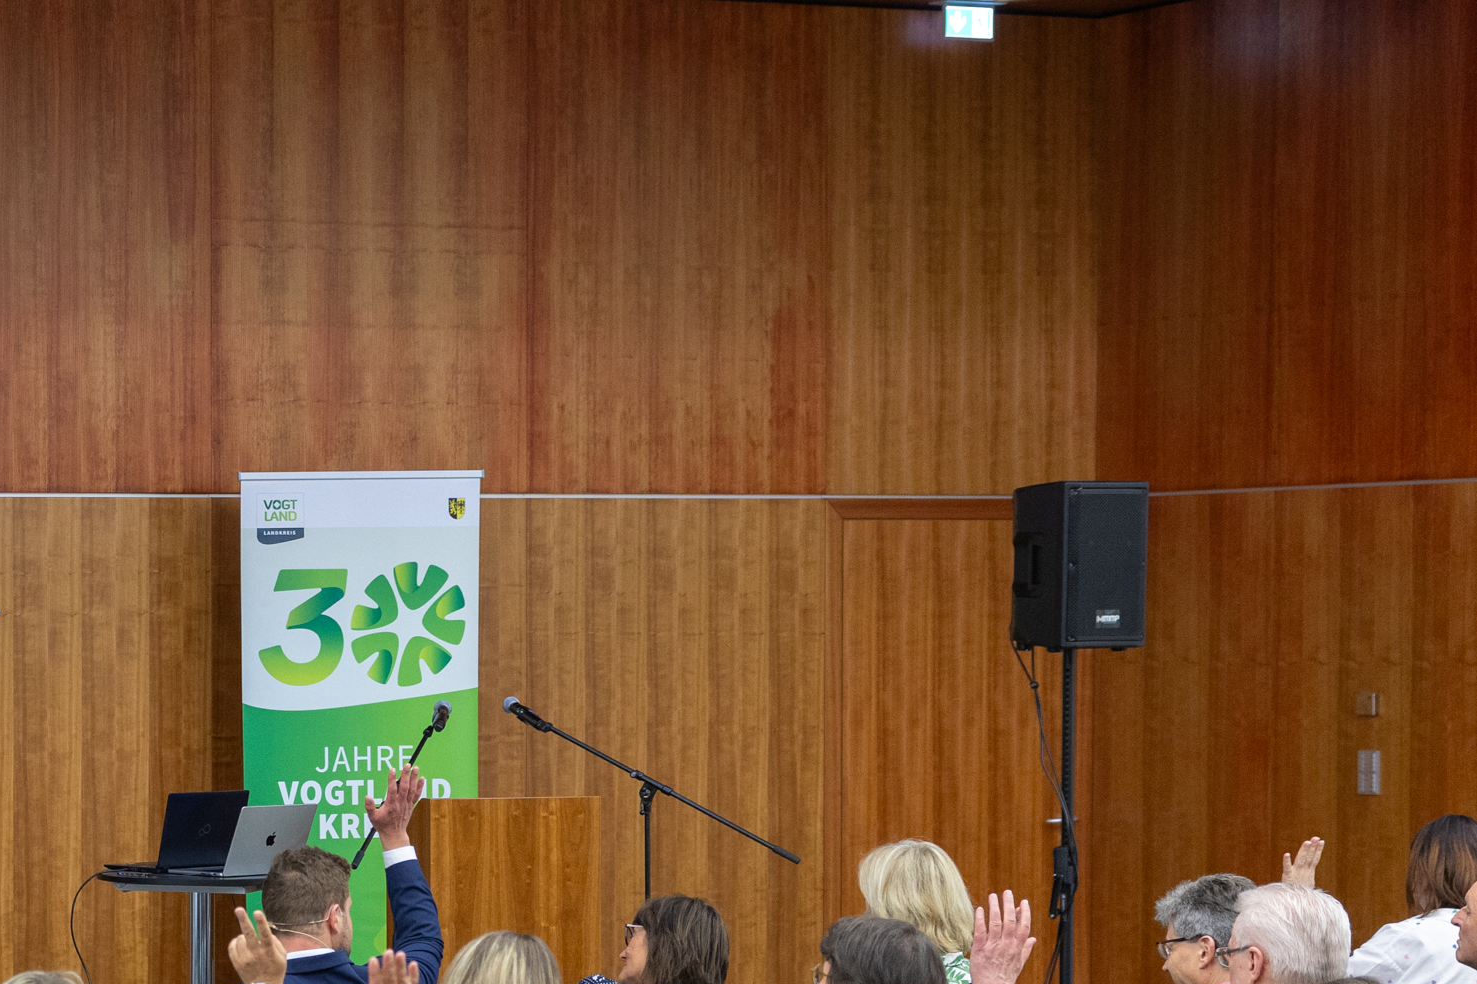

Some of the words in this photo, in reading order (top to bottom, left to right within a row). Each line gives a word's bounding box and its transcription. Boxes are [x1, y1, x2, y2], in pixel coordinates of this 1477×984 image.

[263, 499, 298, 510] VOGT
[264, 511, 297, 521] LAND
[315, 745, 414, 773] JAHRE
[278, 778, 452, 806] VOGTLD
